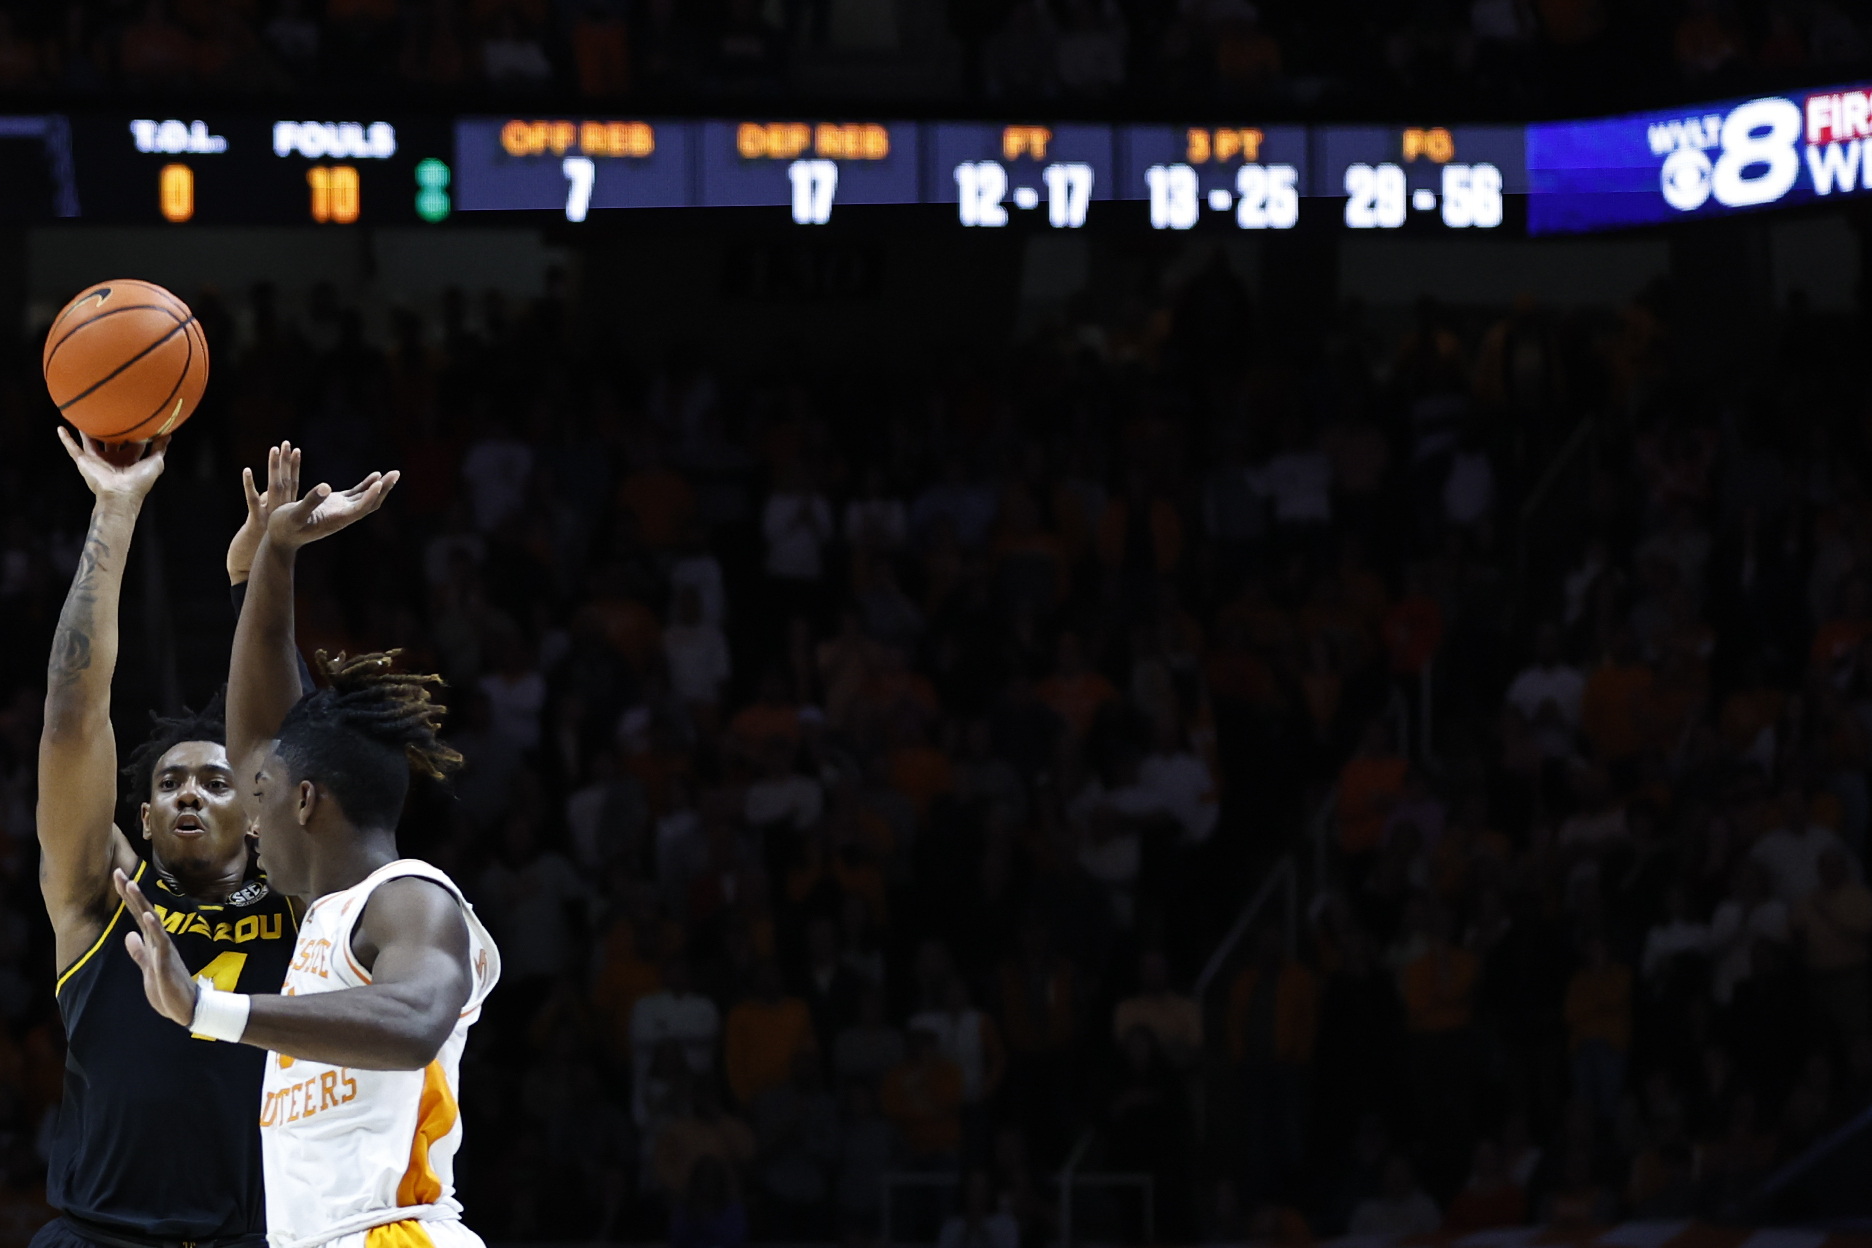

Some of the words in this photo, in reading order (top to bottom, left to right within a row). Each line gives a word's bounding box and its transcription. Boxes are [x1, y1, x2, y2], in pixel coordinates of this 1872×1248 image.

[1805, 90, 1872, 145] FIR
[273, 120, 397, 159] FOULS
[501, 119, 578, 157] OFF
[579, 121, 656, 158] REB
[736, 122, 812, 159] DEF
[813, 123, 890, 161] REB
[1002, 126, 1051, 159] FT
[1187, 128, 1212, 164] 3
[1213, 128, 1264, 162] PT
[1401, 128, 1455, 163] FG
[1710, 95, 1804, 210] 8
[160, 163, 195, 222] 0
[308, 165, 361, 223] 10
[562, 157, 596, 223] 7
[787, 159, 839, 225] 17
[230, 882, 263, 904] SEC
[154, 903, 282, 944] MIZZOU
